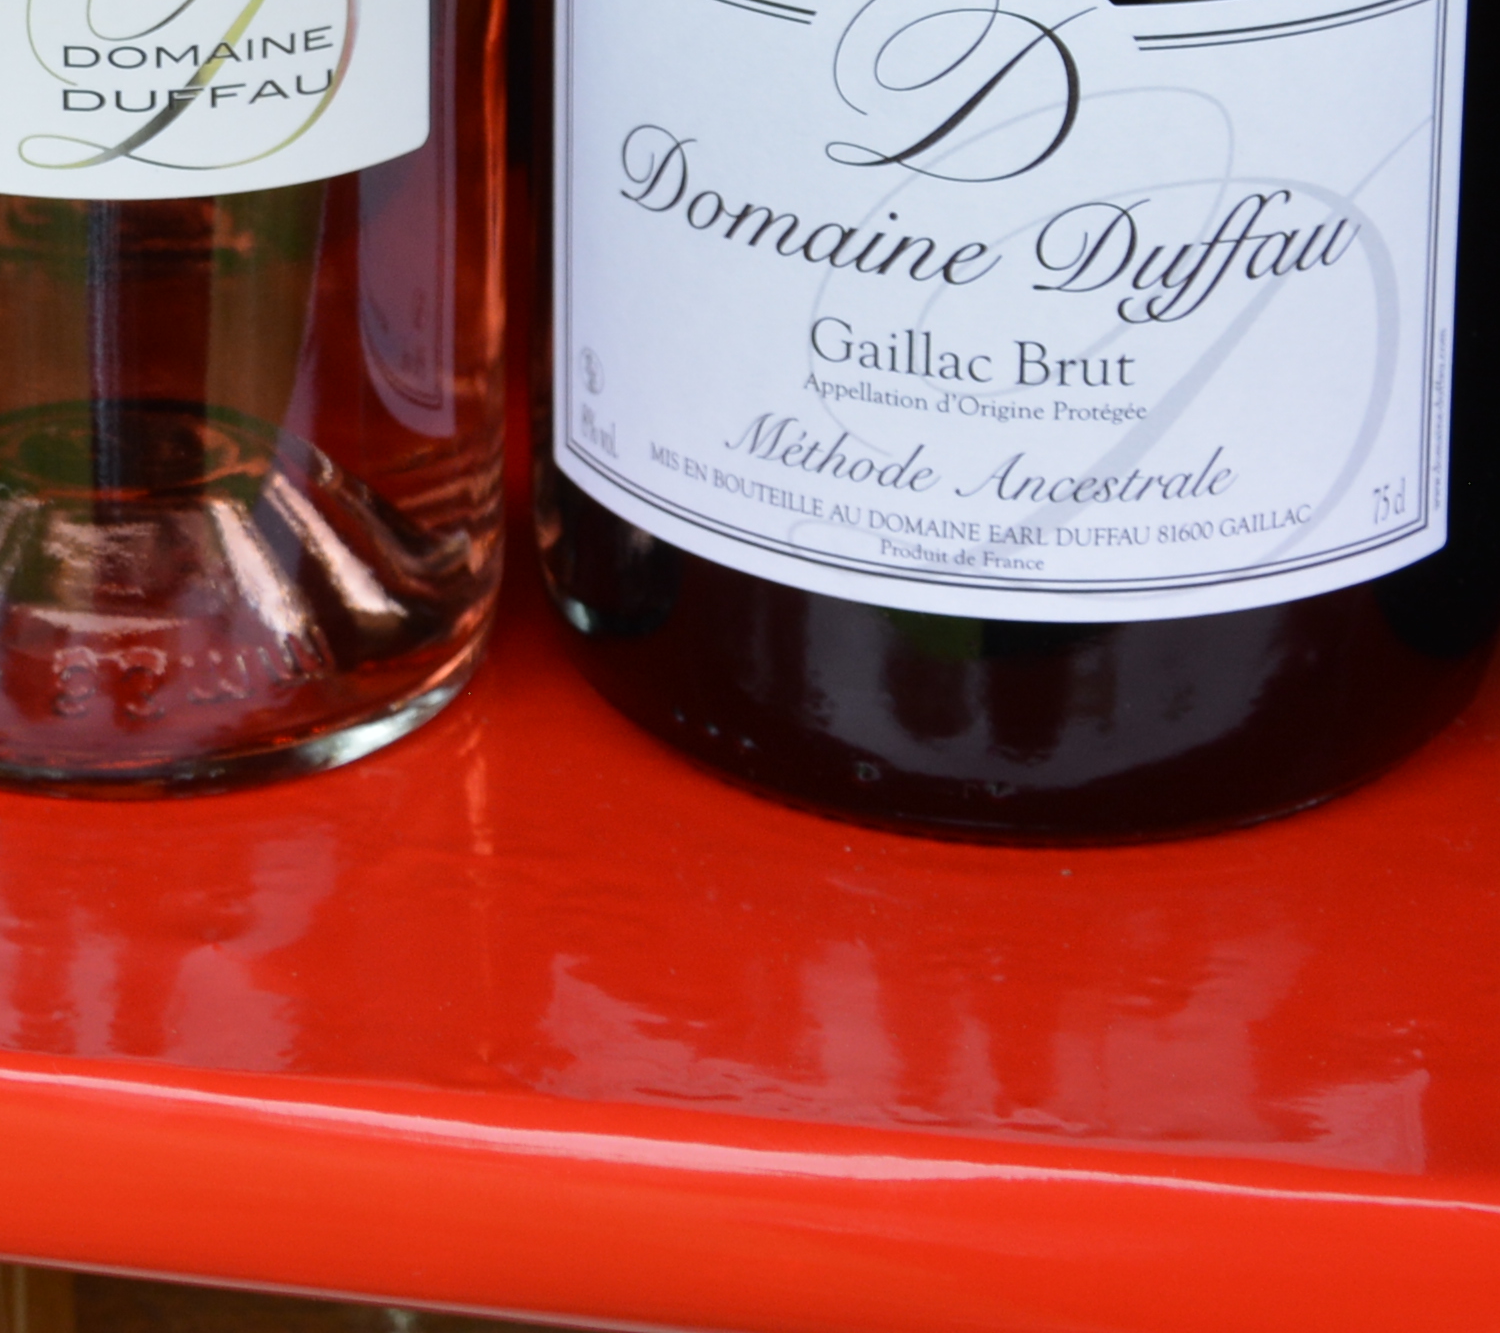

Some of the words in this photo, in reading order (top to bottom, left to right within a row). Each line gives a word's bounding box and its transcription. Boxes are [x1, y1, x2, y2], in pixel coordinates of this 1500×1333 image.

[62, 26, 334, 69] DOMAINE
[62, 68, 335, 112] DUFFAU
[618, 123, 1000, 287] Domaine
[1031, 188, 1361, 325] Duffau
[810, 316, 993, 384] Gaillac
[1013, 340, 1136, 387] Brut
[803, 371, 929, 413] Appellation
[1053, 401, 1148, 425] Protégée
[724, 413, 942, 493] Méthode
[955, 445, 1239, 504] Ancestrale
[650, 441, 680, 471] MIS
[684, 459, 708, 482] EN
[712, 471, 824, 518] BOUTEILLE
[829, 504, 862, 526] AU
[869, 509, 981, 543] DOMAINE
[988, 524, 1049, 547] EARL
[1056, 525, 1151, 547] DUFFAU
[1157, 522, 1214, 545] 81600
[1219, 504, 1313, 538] GAILLAC
[880, 539, 948, 565] Produit
[953, 549, 977, 567] de
[982, 551, 1046, 572] France
